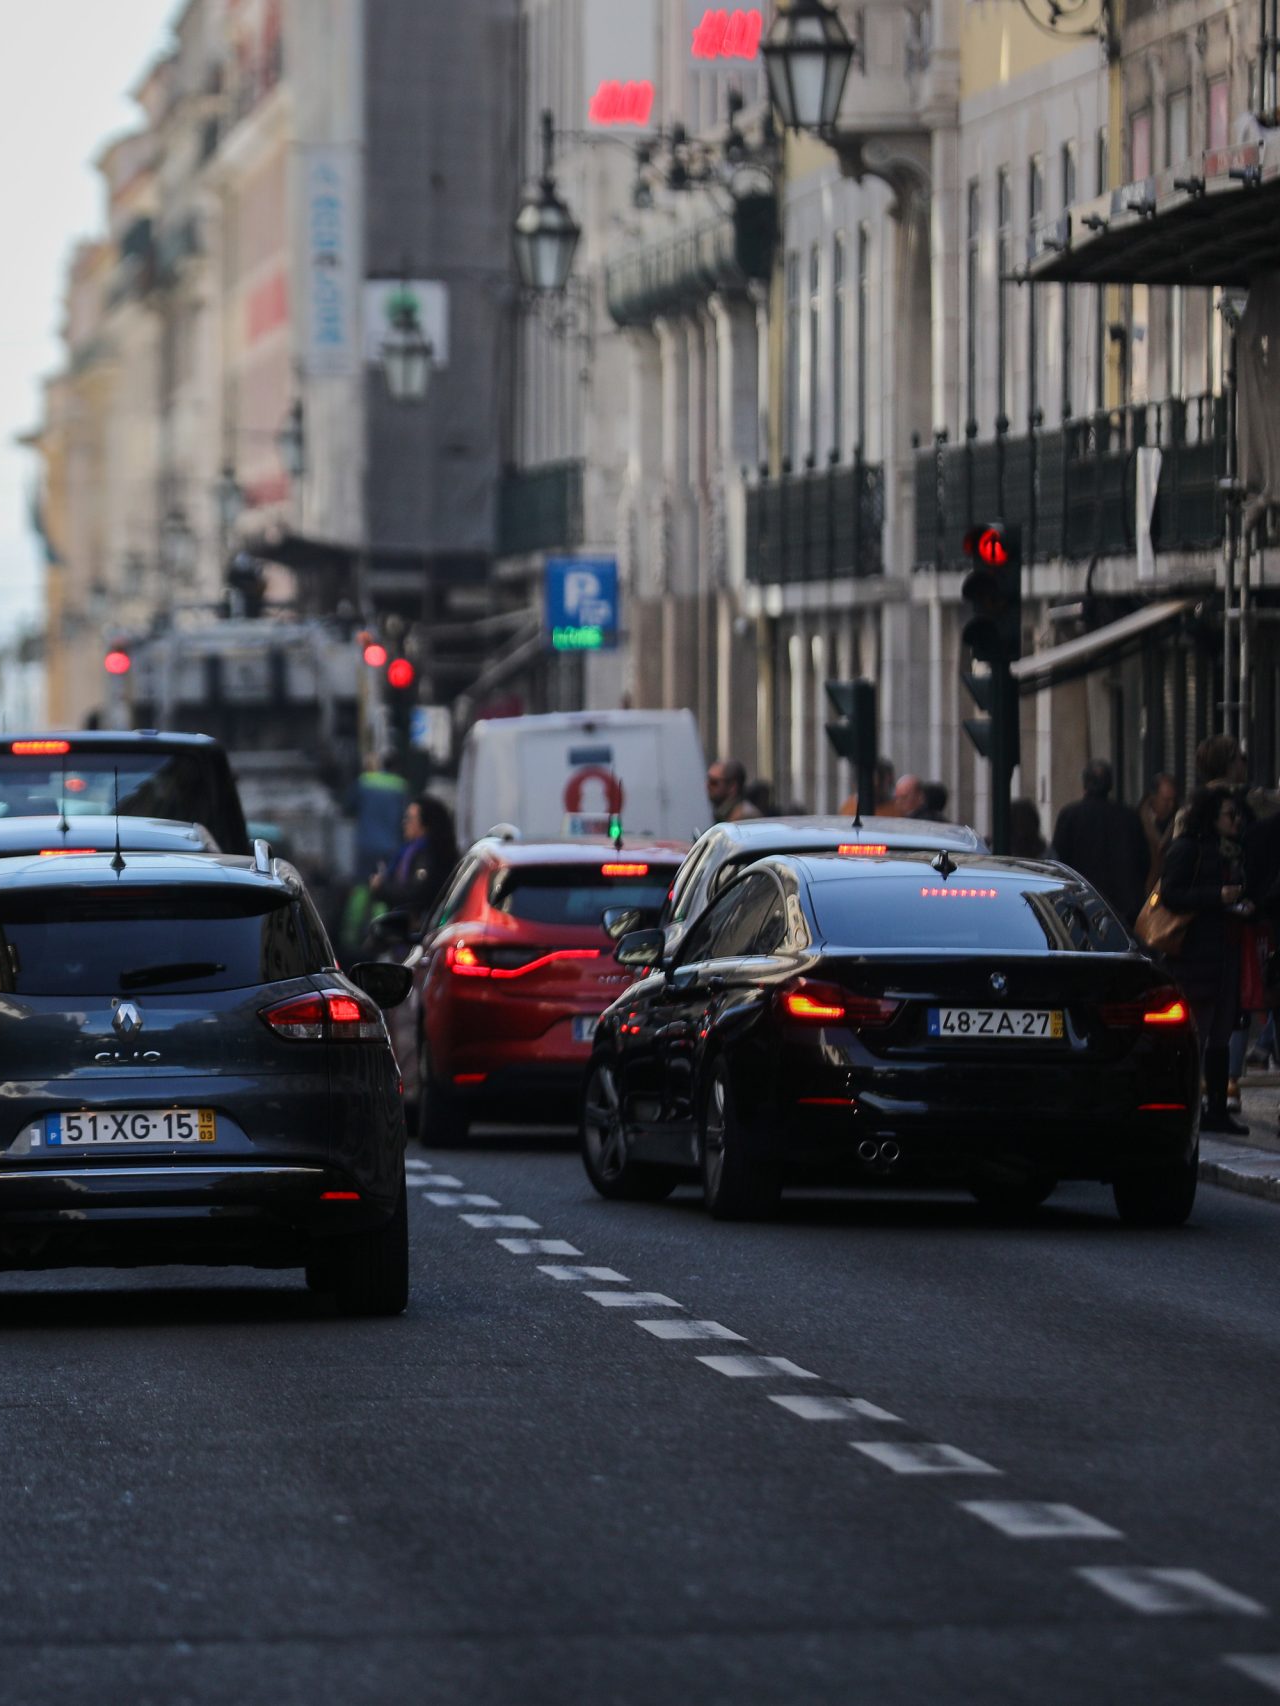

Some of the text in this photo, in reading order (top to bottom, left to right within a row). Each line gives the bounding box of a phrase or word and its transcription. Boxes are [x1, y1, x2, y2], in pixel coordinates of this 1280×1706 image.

[564, 571, 601, 615] P
[94, 1050, 161, 1064] CLIO
[201, 1112, 212, 1123] 19
[50, 1132, 57, 1141] P
[200, 1131, 213, 1140] 03
